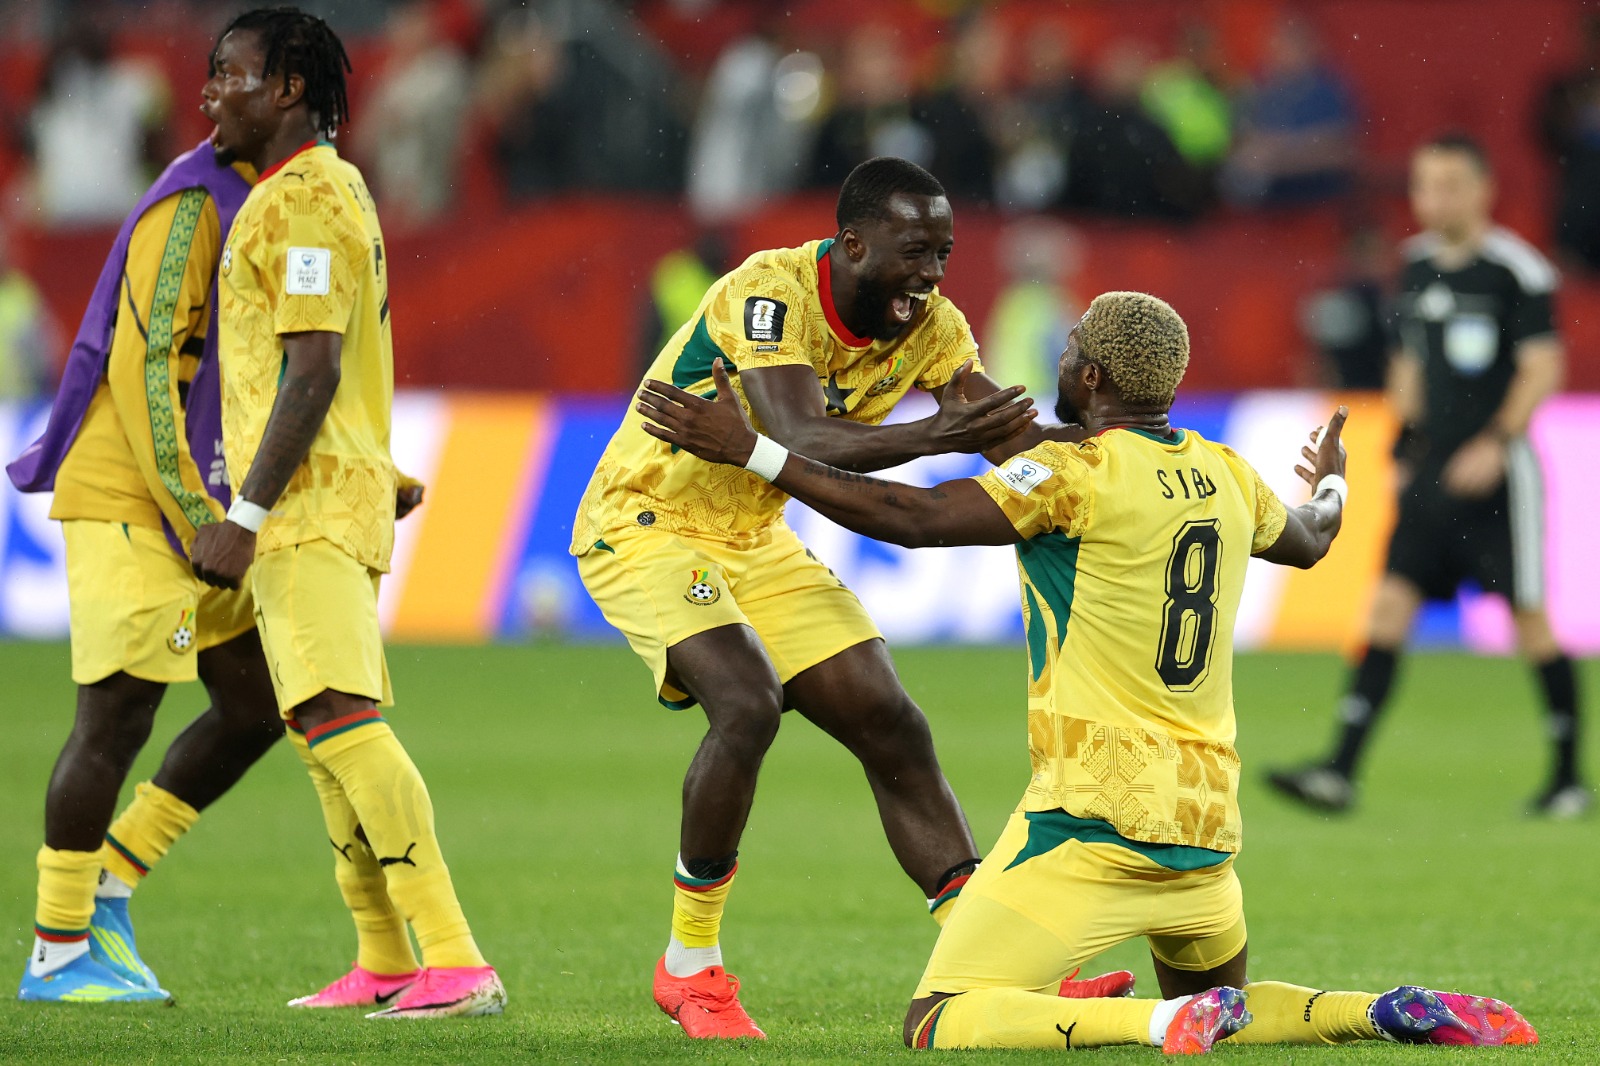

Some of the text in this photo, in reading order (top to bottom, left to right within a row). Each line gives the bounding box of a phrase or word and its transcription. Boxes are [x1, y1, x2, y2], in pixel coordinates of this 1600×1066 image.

[298, 276, 317, 284] PEACE
[1154, 518, 1224, 693] 8
[1303, 990, 1327, 1023] GHAN
